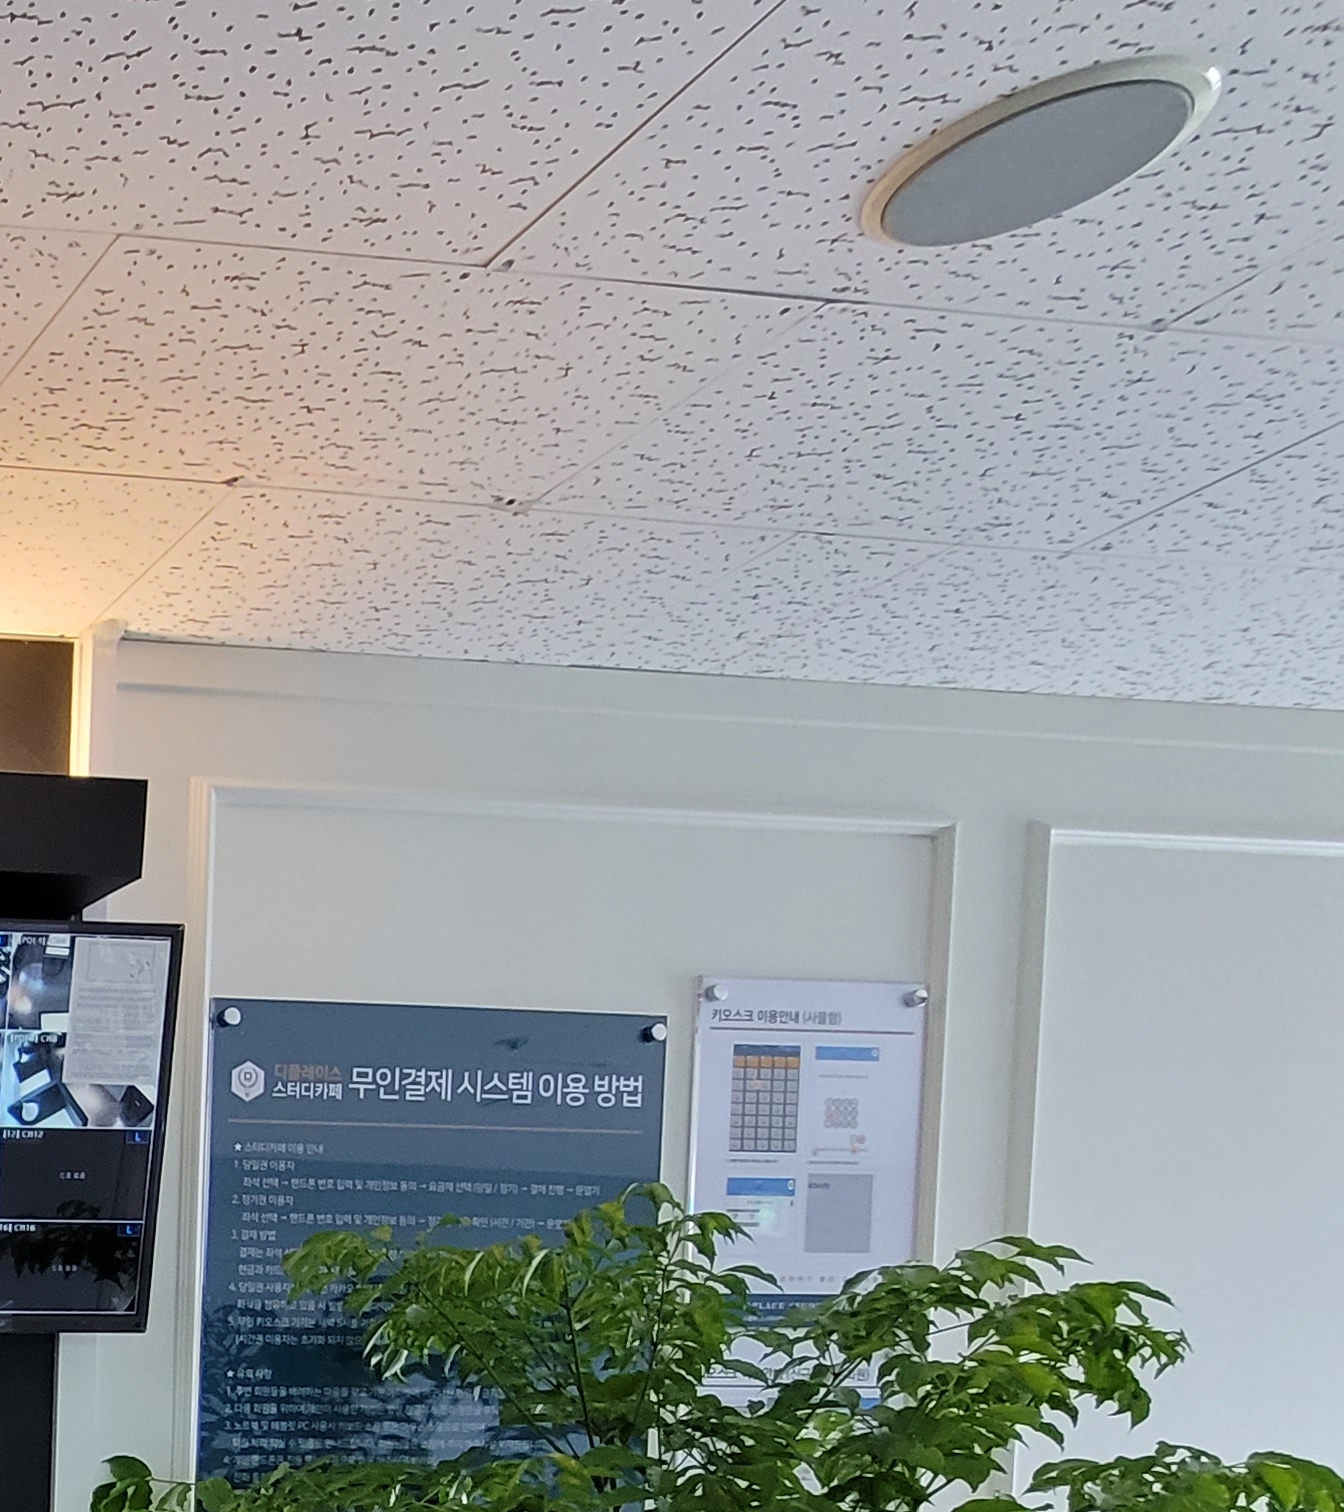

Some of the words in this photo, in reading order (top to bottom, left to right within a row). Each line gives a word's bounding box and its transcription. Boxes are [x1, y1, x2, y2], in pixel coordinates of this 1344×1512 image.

[711, 1008, 755, 1023] 키오스크
[757, 1010, 800, 1024] 이용안내
[274, 1063, 342, 1080] 디플레이스
[272, 1081, 343, 1100] 스터디카페
[348, 1067, 452, 1102] 무인결제
[457, 1069, 533, 1105] 시스템
[539, 1073, 589, 1107] 이용
[594, 1074, 643, 1108] 방법
